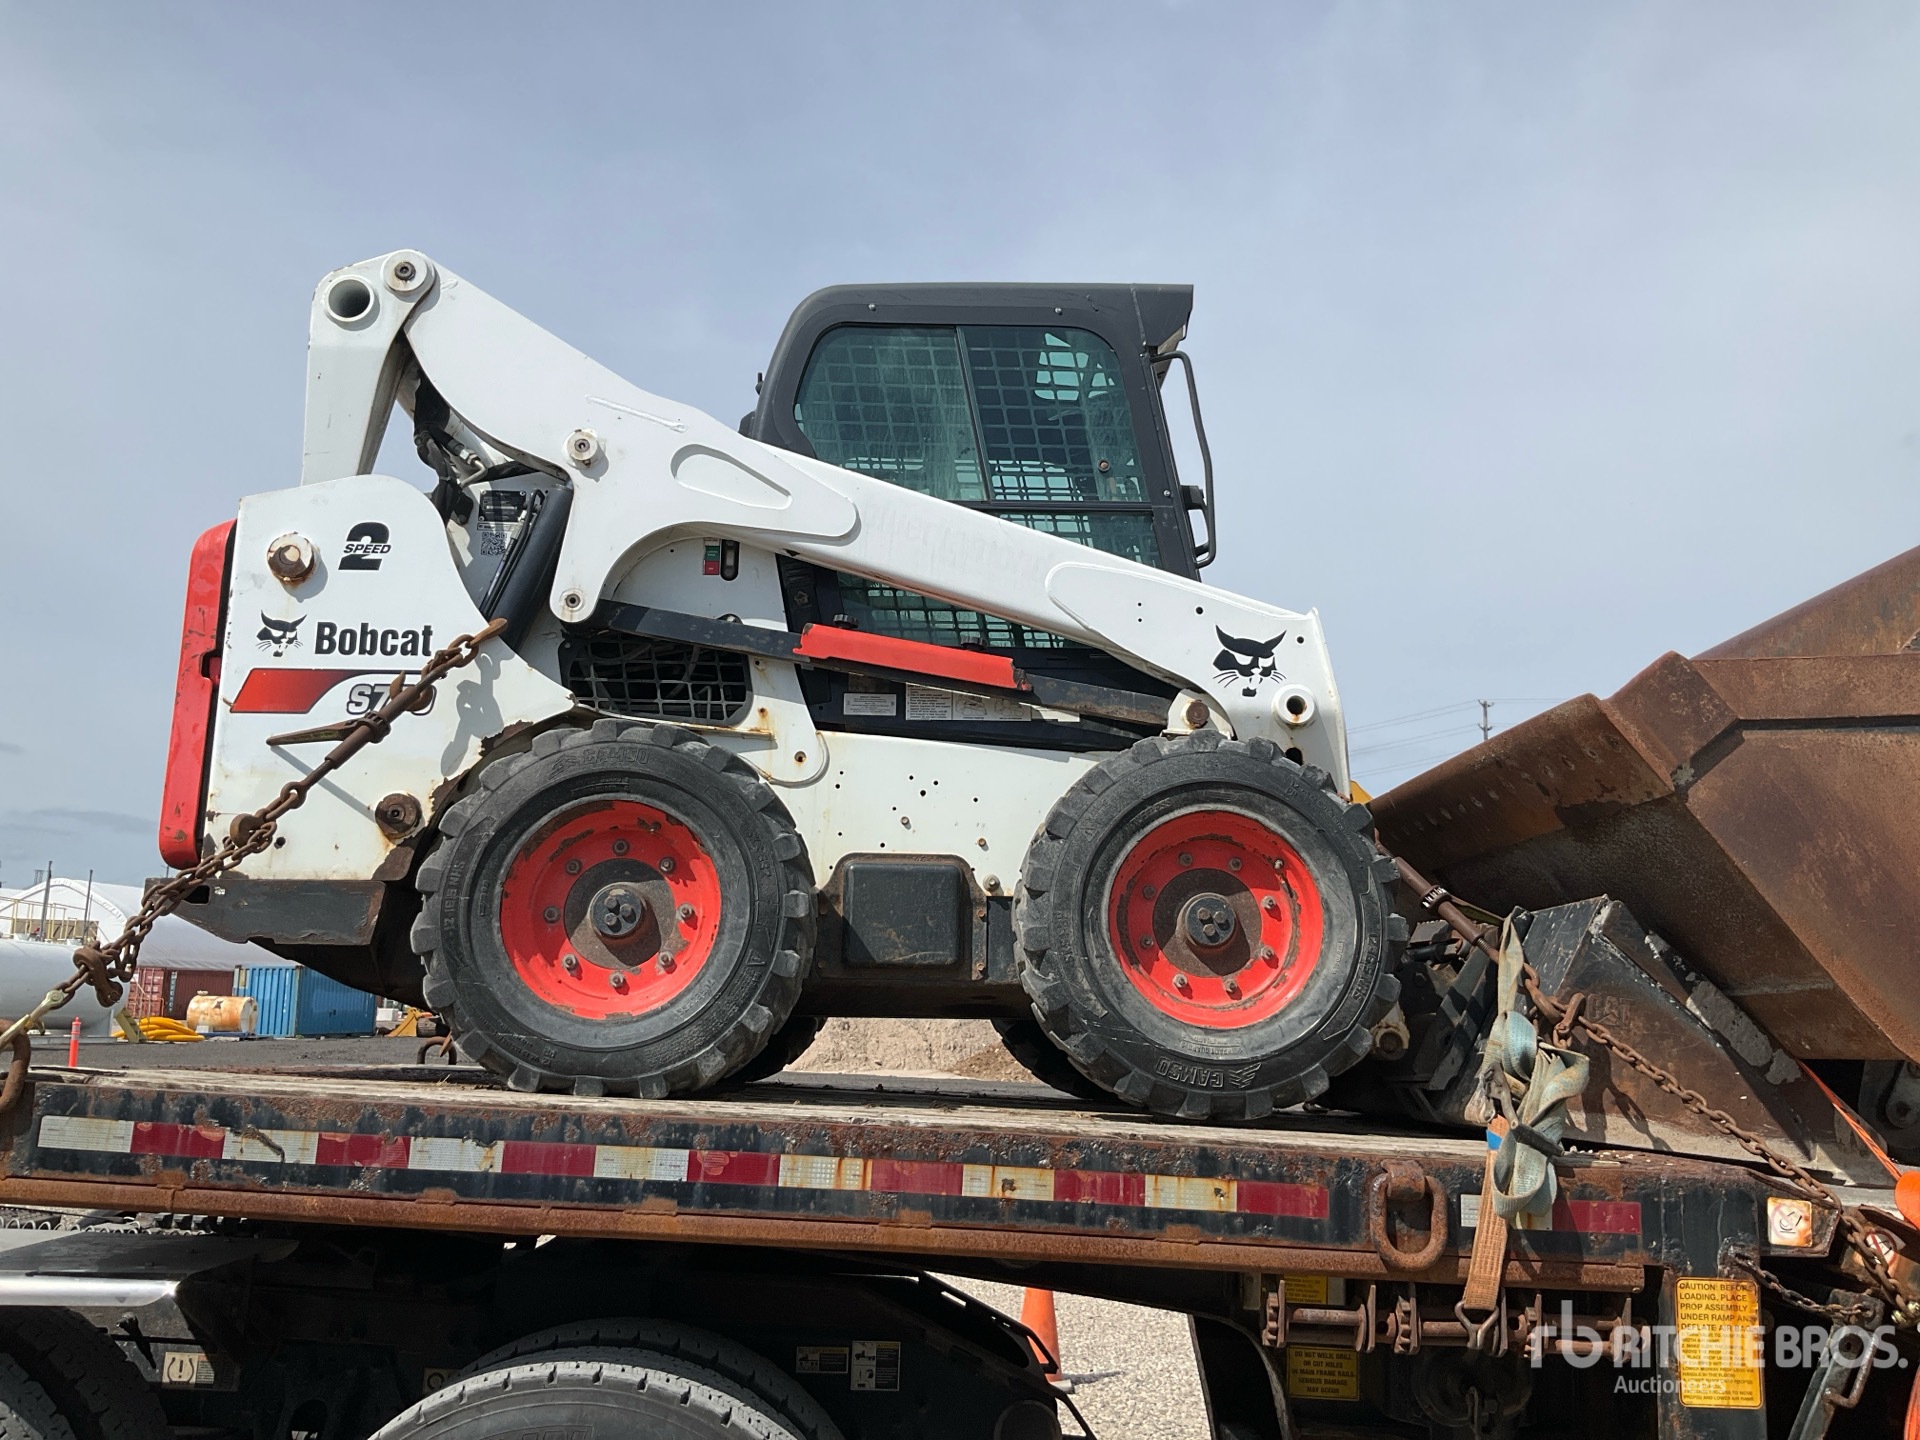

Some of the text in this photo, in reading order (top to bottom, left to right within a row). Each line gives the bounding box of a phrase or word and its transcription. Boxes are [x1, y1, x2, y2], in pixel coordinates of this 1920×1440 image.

[338, 521, 390, 571] 2
[343, 543, 392, 554] SPEED
[314, 621, 433, 656] Bobcat
[1587, 993, 1633, 1027] CAT
[1155, 1056, 1225, 1088] CAMSO
[1679, 1282, 1718, 1291] CAUTION:
[1720, 1294, 1748, 1302] PLACE
[1680, 1303, 1748, 1312] PROP ASSEMBLY
[1680, 1313, 1709, 1321] UNDER
[1711, 1314, 1736, 1322] RAMP
[1680, 1323, 1717, 1331] DEFLATE
